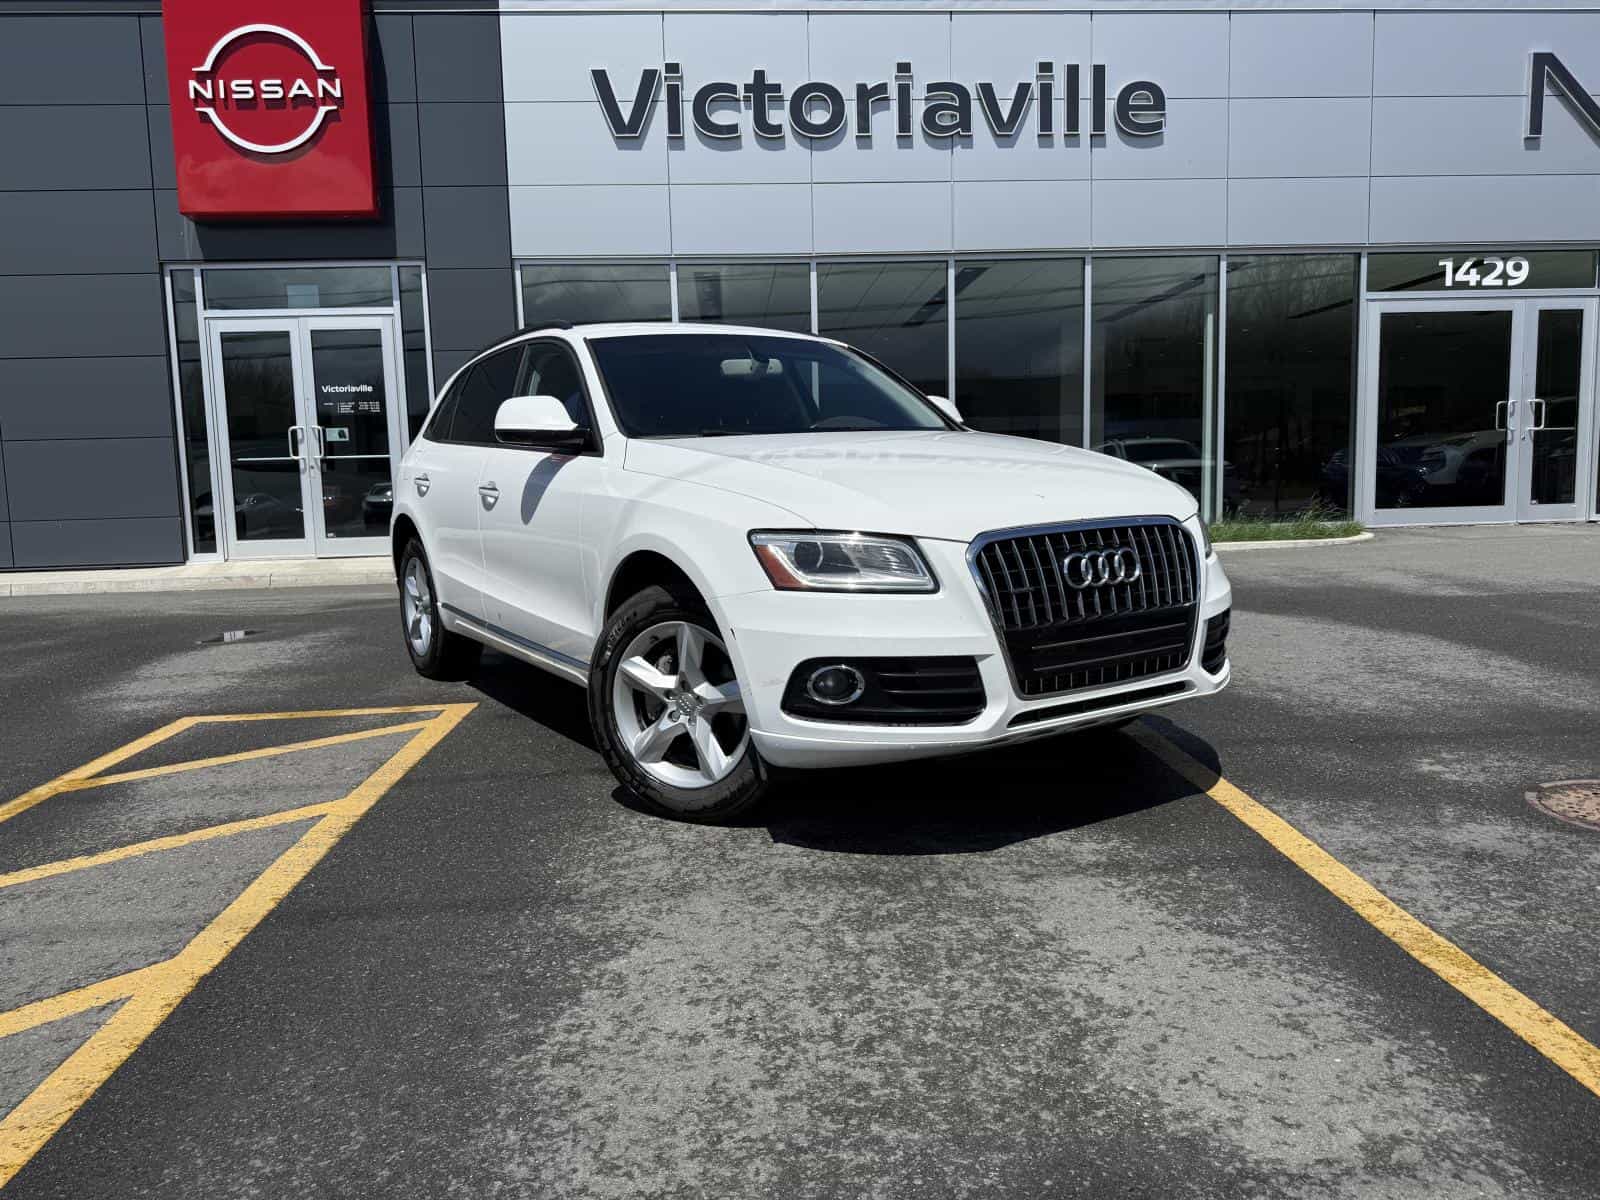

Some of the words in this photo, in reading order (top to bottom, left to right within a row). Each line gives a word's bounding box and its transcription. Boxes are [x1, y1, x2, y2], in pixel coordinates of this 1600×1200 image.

[188, 78, 342, 99] NISSAN
[589, 61, 1168, 139] Victoriaville
[1438, 256, 1530, 287] 1429
[321, 384, 374, 393] Victoriaville
